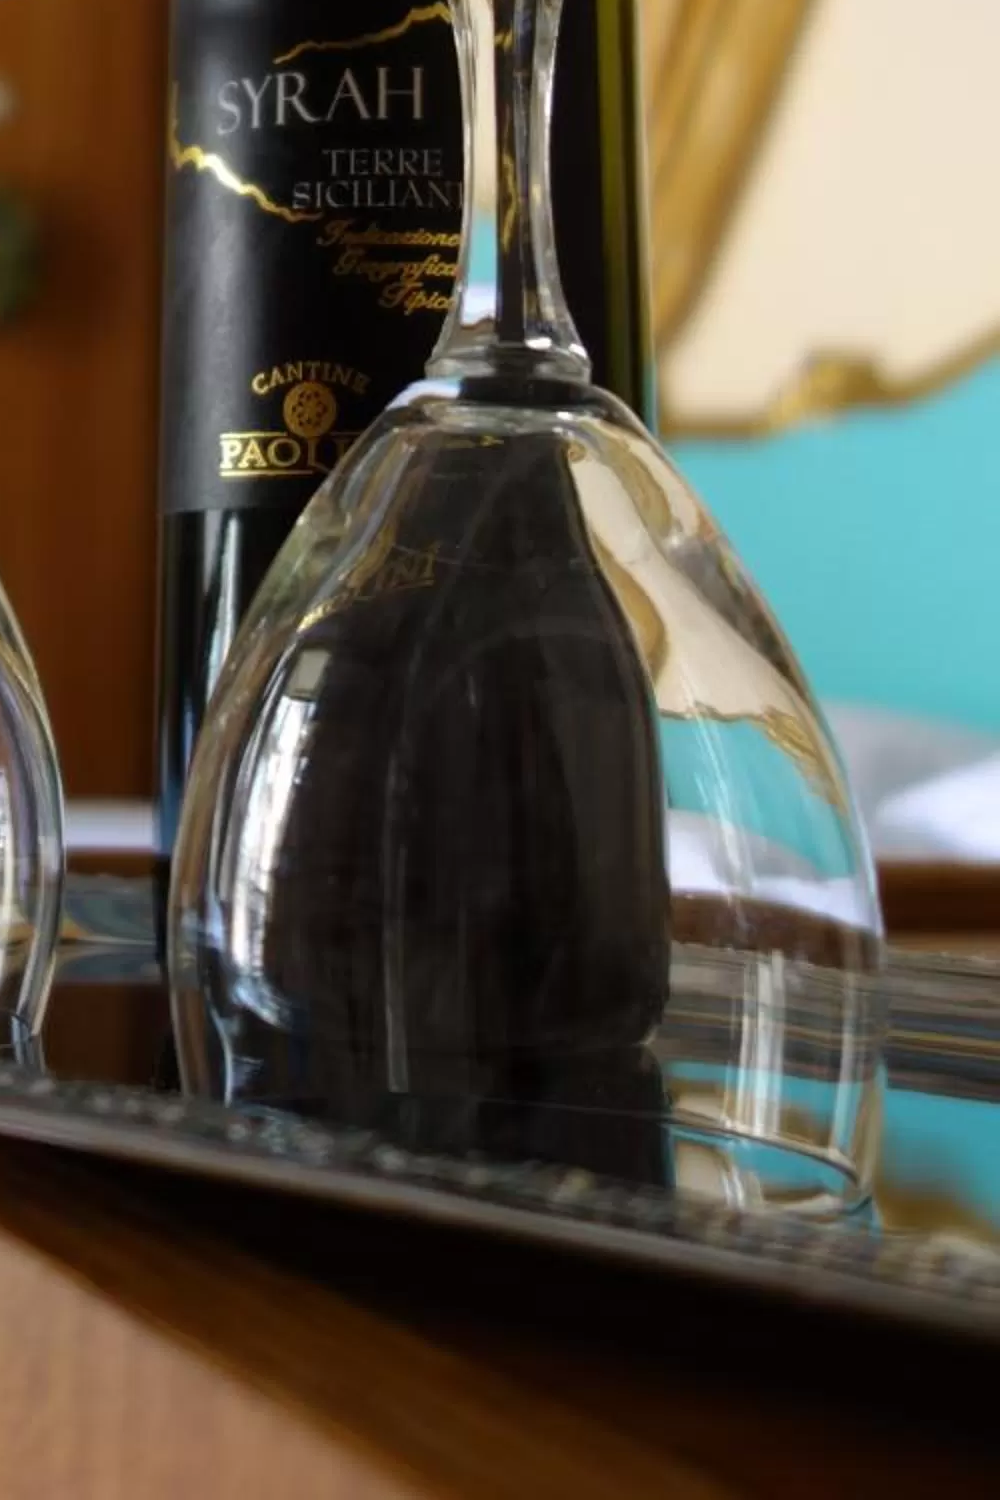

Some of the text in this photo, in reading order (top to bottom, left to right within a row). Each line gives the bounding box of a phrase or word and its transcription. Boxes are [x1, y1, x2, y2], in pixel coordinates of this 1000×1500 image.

[217, 67, 424, 135] SYRAH
[322, 148, 442, 177] TERRE
[251, 361, 371, 395] CANTINE
